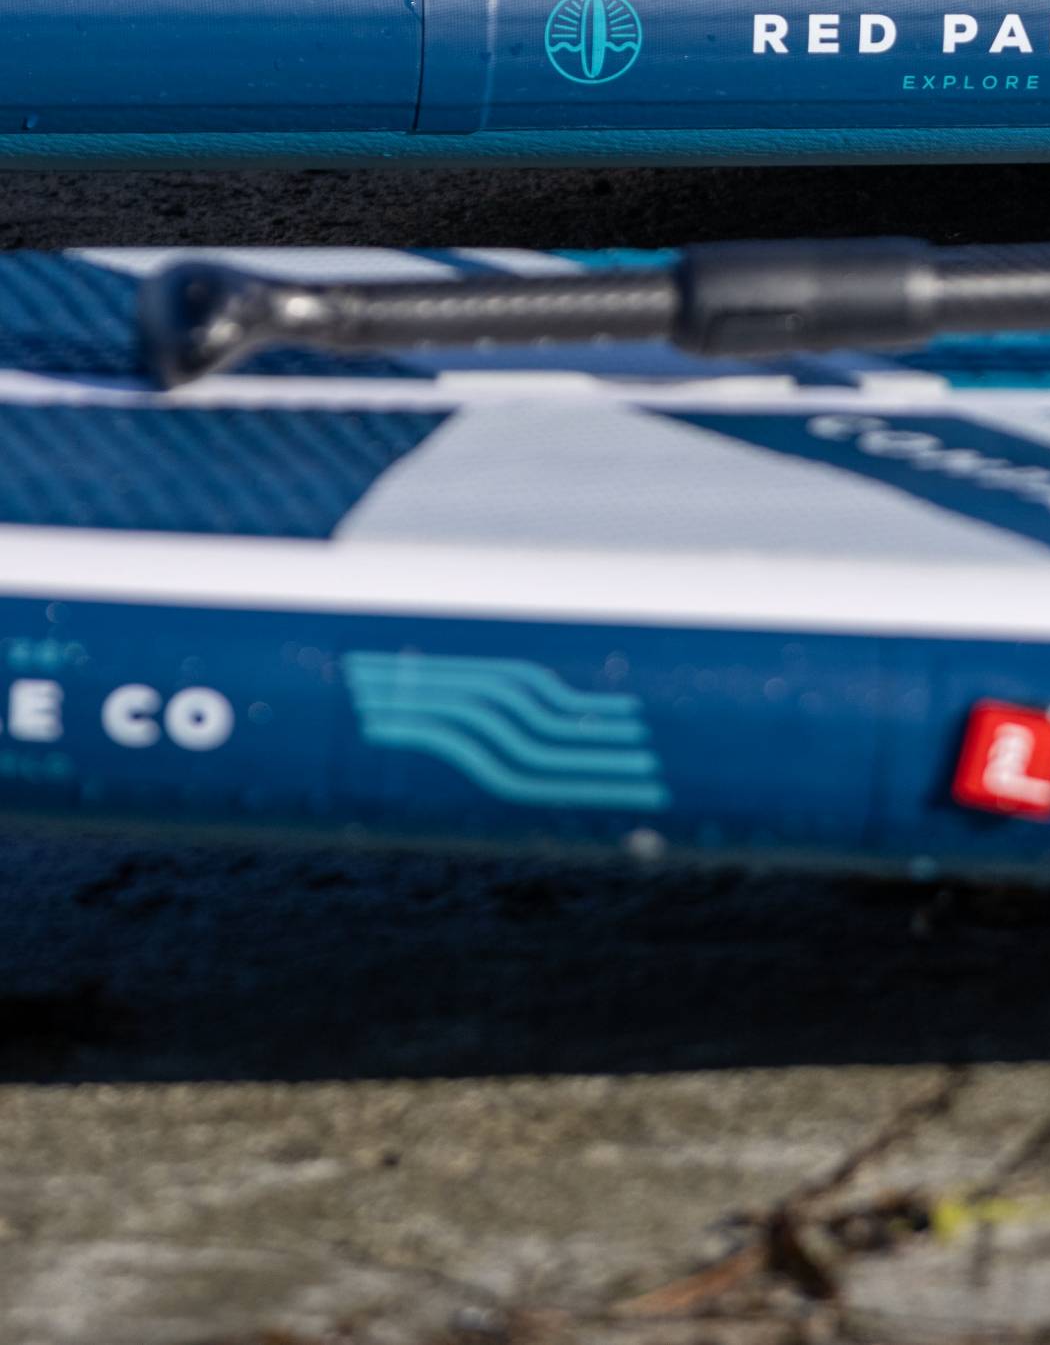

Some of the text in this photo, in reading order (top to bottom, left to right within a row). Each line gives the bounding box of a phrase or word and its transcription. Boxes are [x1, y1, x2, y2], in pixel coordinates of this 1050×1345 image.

[752, 13, 897, 53] RED
[902, 74, 1040, 90] EXPLORE
[100, 682, 236, 752] CO
